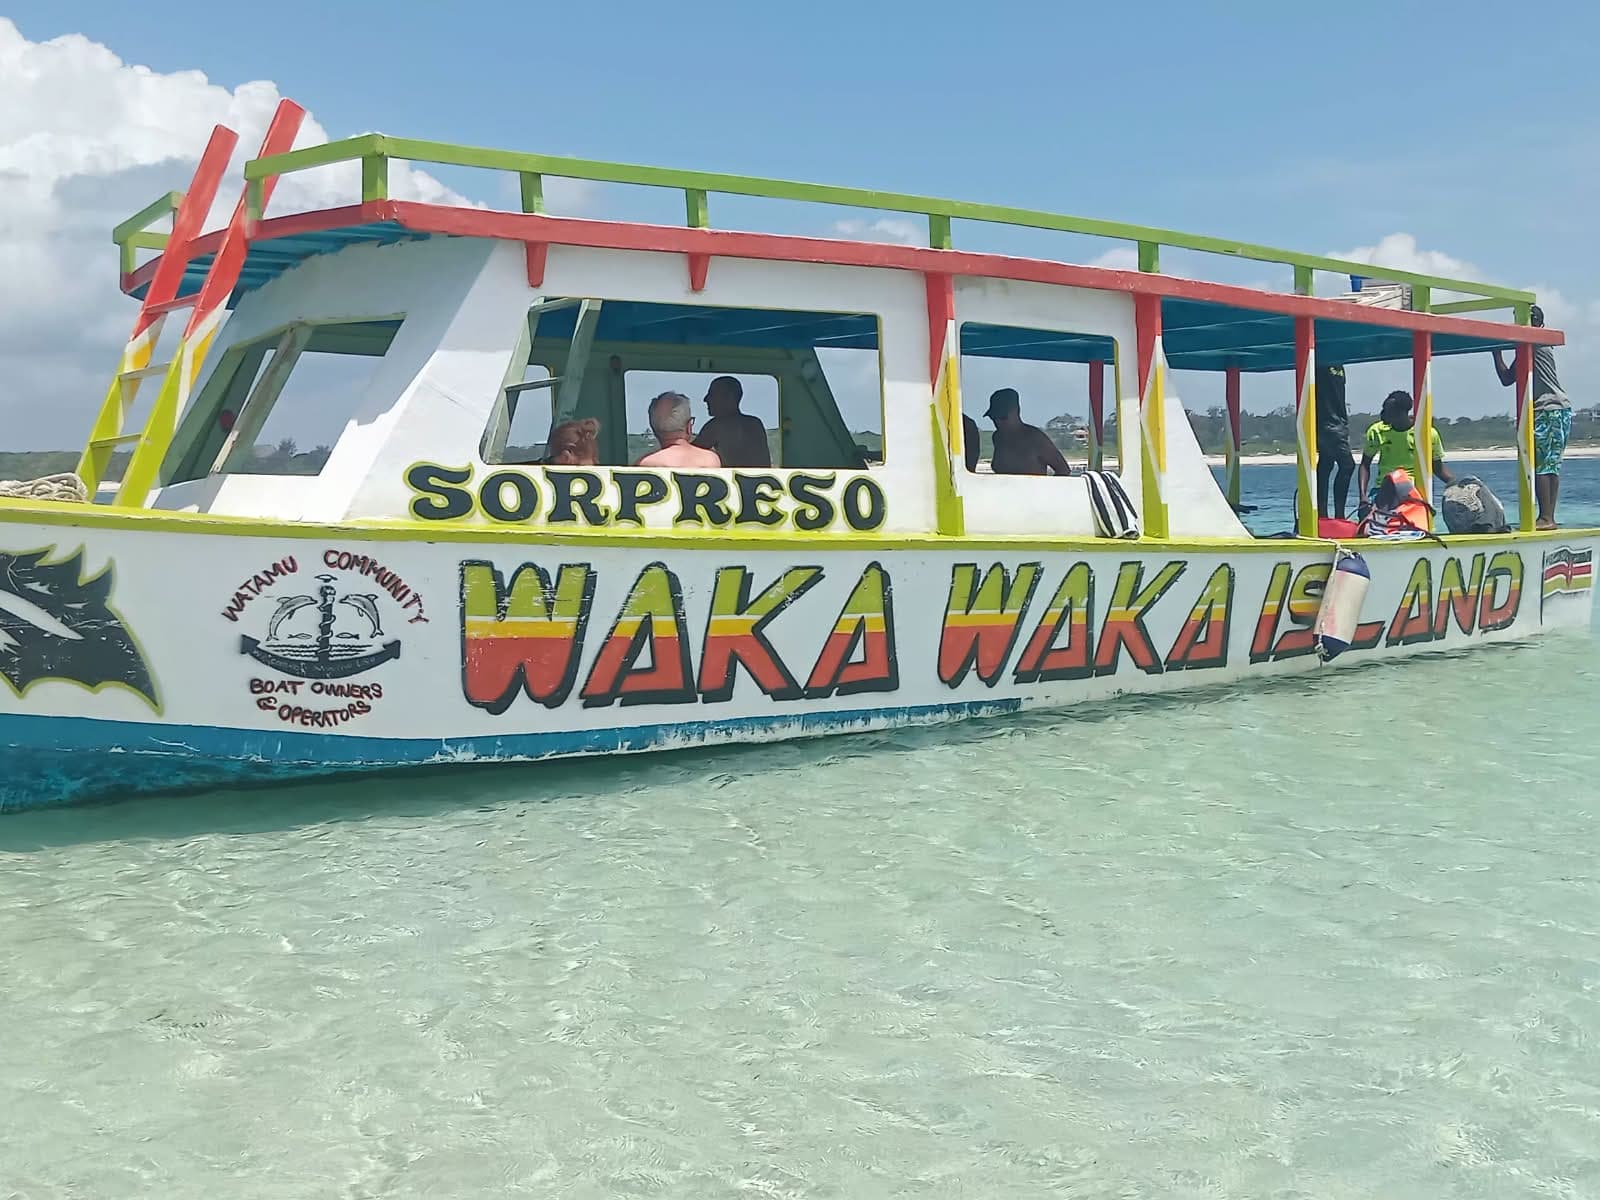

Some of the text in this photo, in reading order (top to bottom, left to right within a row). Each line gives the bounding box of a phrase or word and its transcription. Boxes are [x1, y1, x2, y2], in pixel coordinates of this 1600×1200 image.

[403, 461, 886, 531] SORPRESO
[221, 549, 429, 624] WATAMU COMMUNITY
[459, 559, 900, 715] WAKA
[937, 560, 1236, 689] WAKA
[249, 678, 383, 700] BOAT OWNERS
[277, 700, 371, 728] OPERATORS
